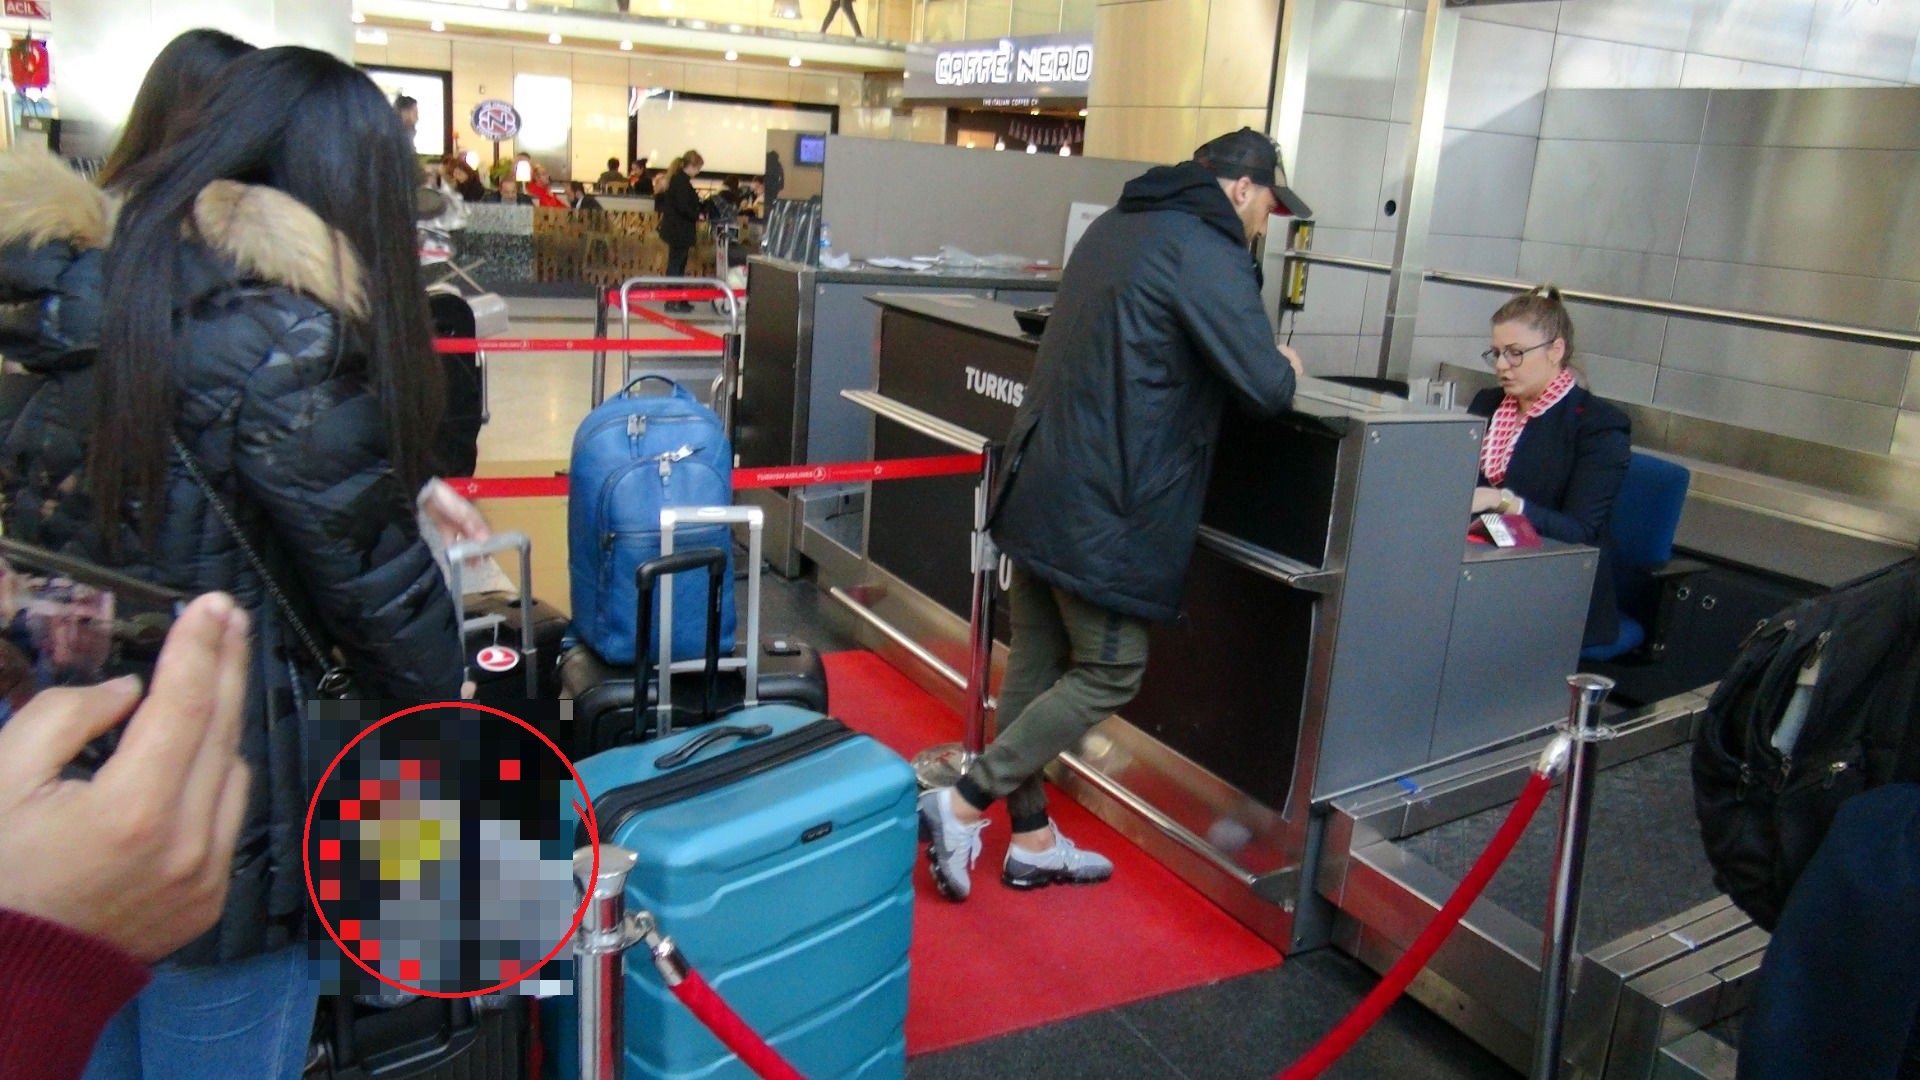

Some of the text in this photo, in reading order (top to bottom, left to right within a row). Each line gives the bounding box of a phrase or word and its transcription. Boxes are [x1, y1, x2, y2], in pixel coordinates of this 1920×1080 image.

[1016, 45, 1092, 82] NERO
[991, 98, 1010, 106] ITALIAN
[1011, 98, 1029, 106] COFFEE
[965, 365, 1026, 408] TURKIS
